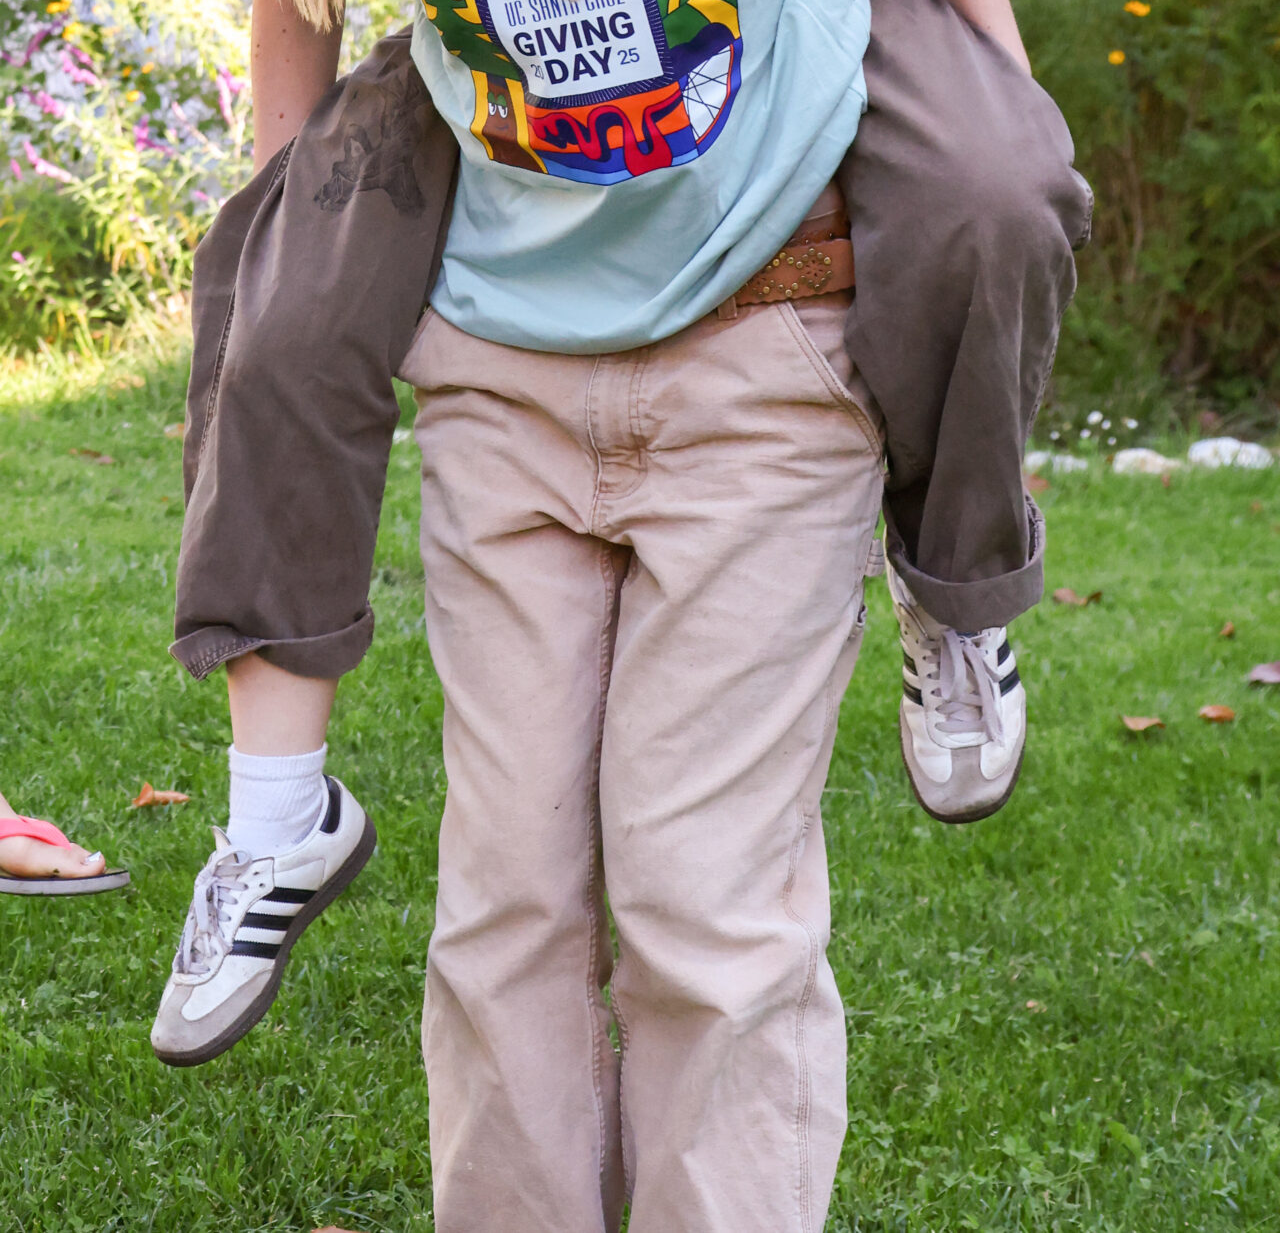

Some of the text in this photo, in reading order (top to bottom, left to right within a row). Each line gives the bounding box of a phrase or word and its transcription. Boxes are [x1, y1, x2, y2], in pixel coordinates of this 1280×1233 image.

[504, 0, 526, 27] UC
[513, 11, 635, 57] GIVING
[544, 46, 612, 85] DAY
[616, 47, 640, 65] 25
